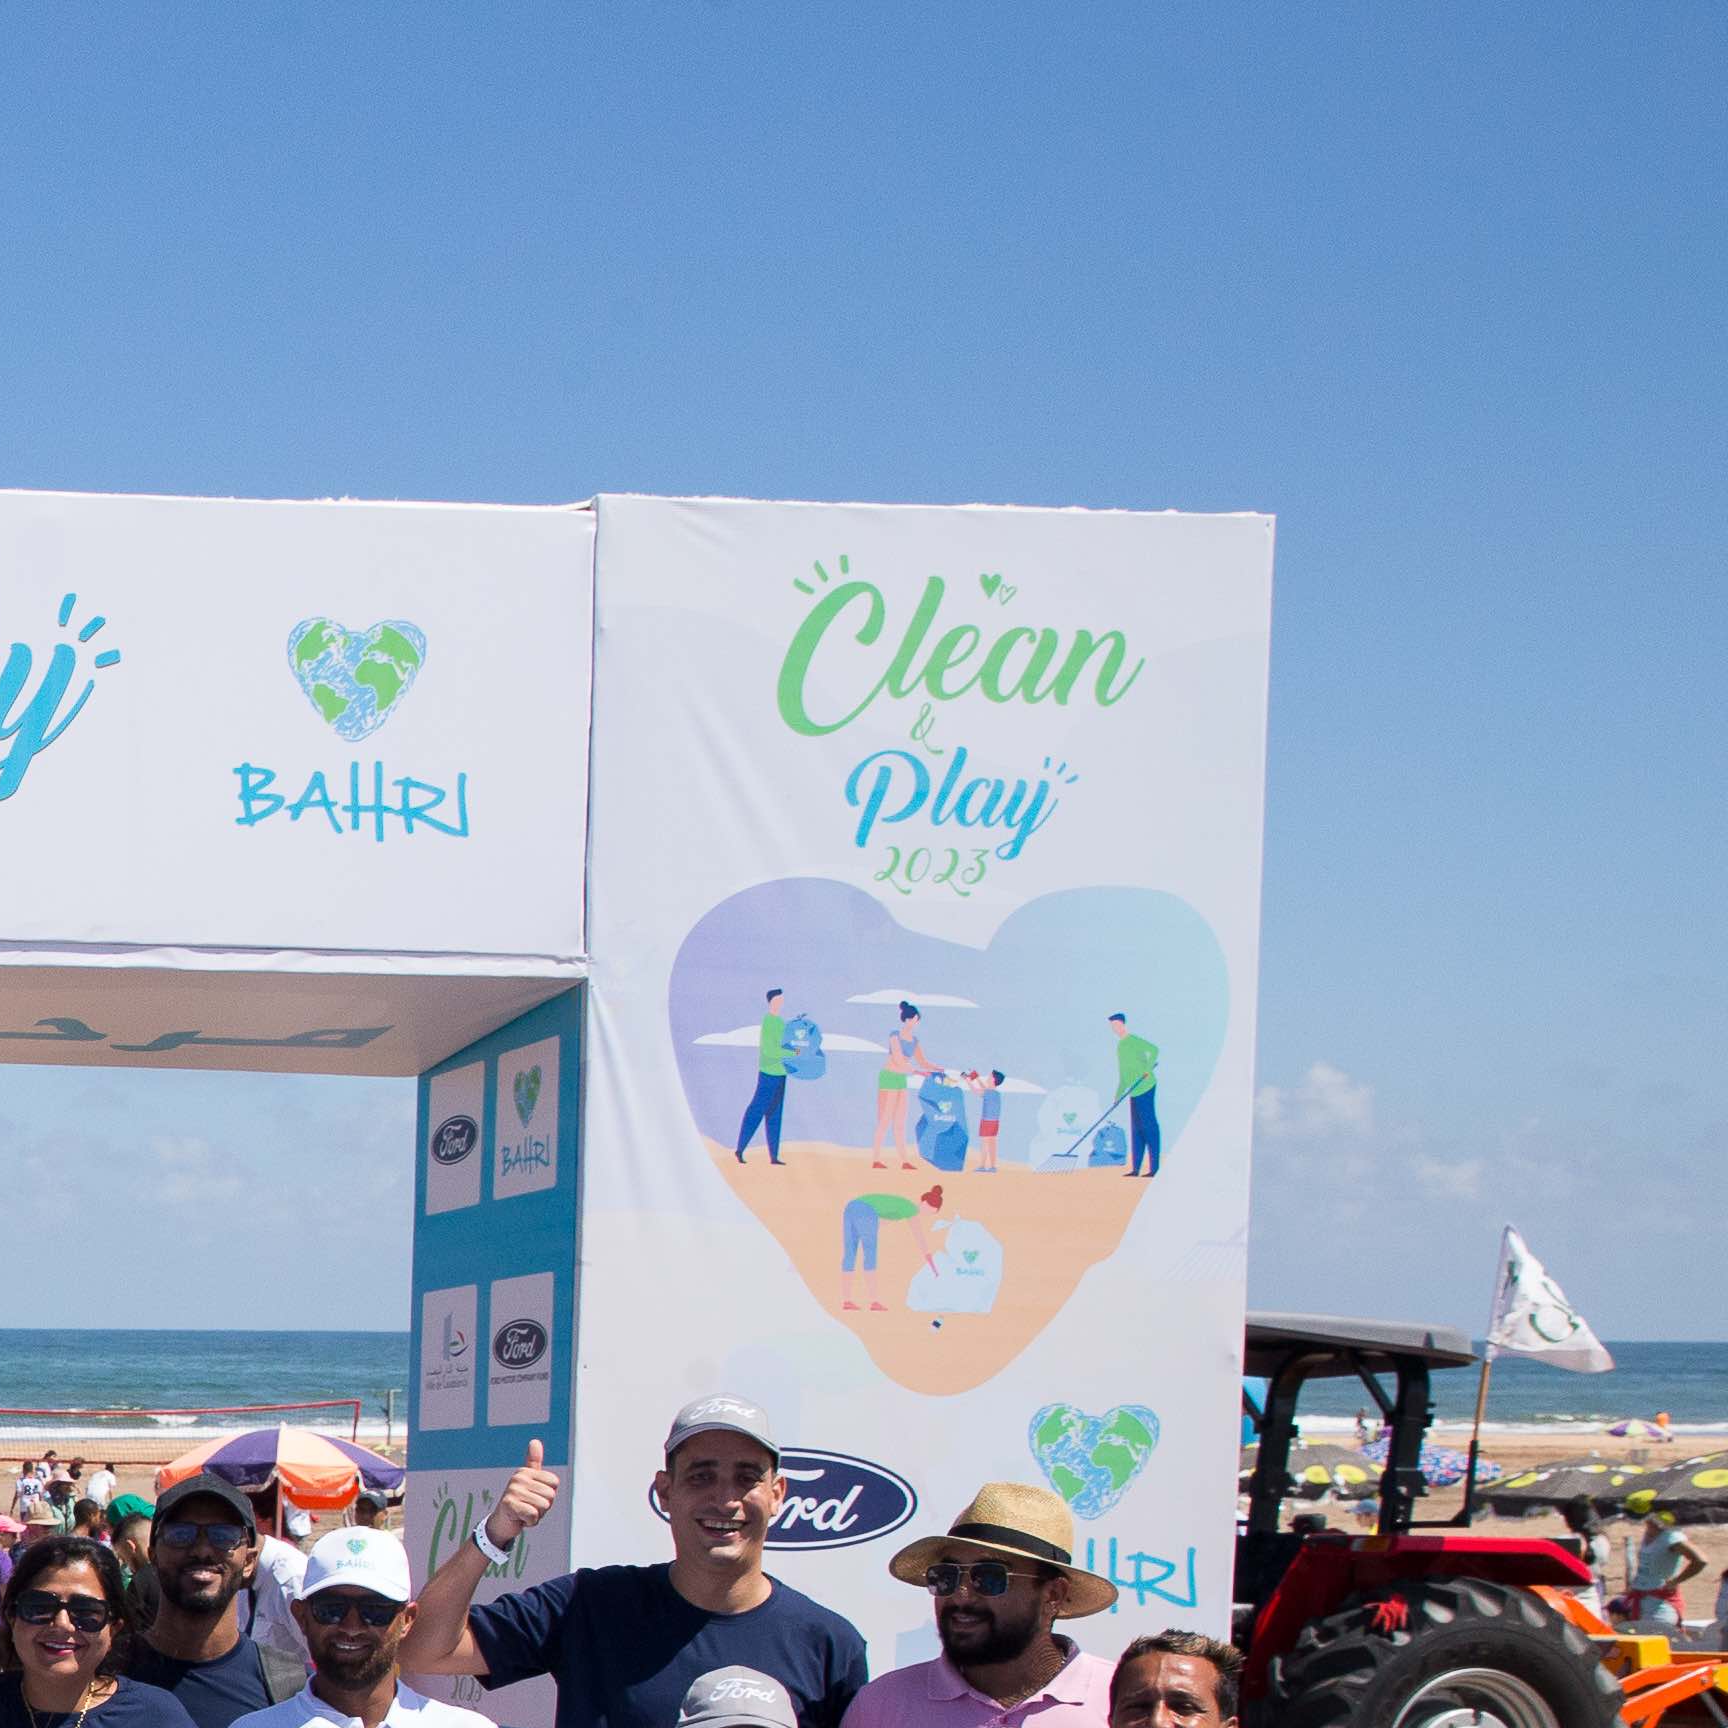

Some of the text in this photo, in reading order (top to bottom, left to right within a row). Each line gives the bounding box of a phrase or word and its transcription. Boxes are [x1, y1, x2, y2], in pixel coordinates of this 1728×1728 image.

[776, 576, 1145, 736] Clean
[910, 702, 943, 755] &
[233, 759, 468, 842] BAHRI
[844, 746, 1058, 860] Play
[874, 845, 990, 897] 2023
[501, 1133, 550, 1177] BAHRI
[690, 1398, 756, 1419] Ford
[710, 1678, 778, 1705] Ford
